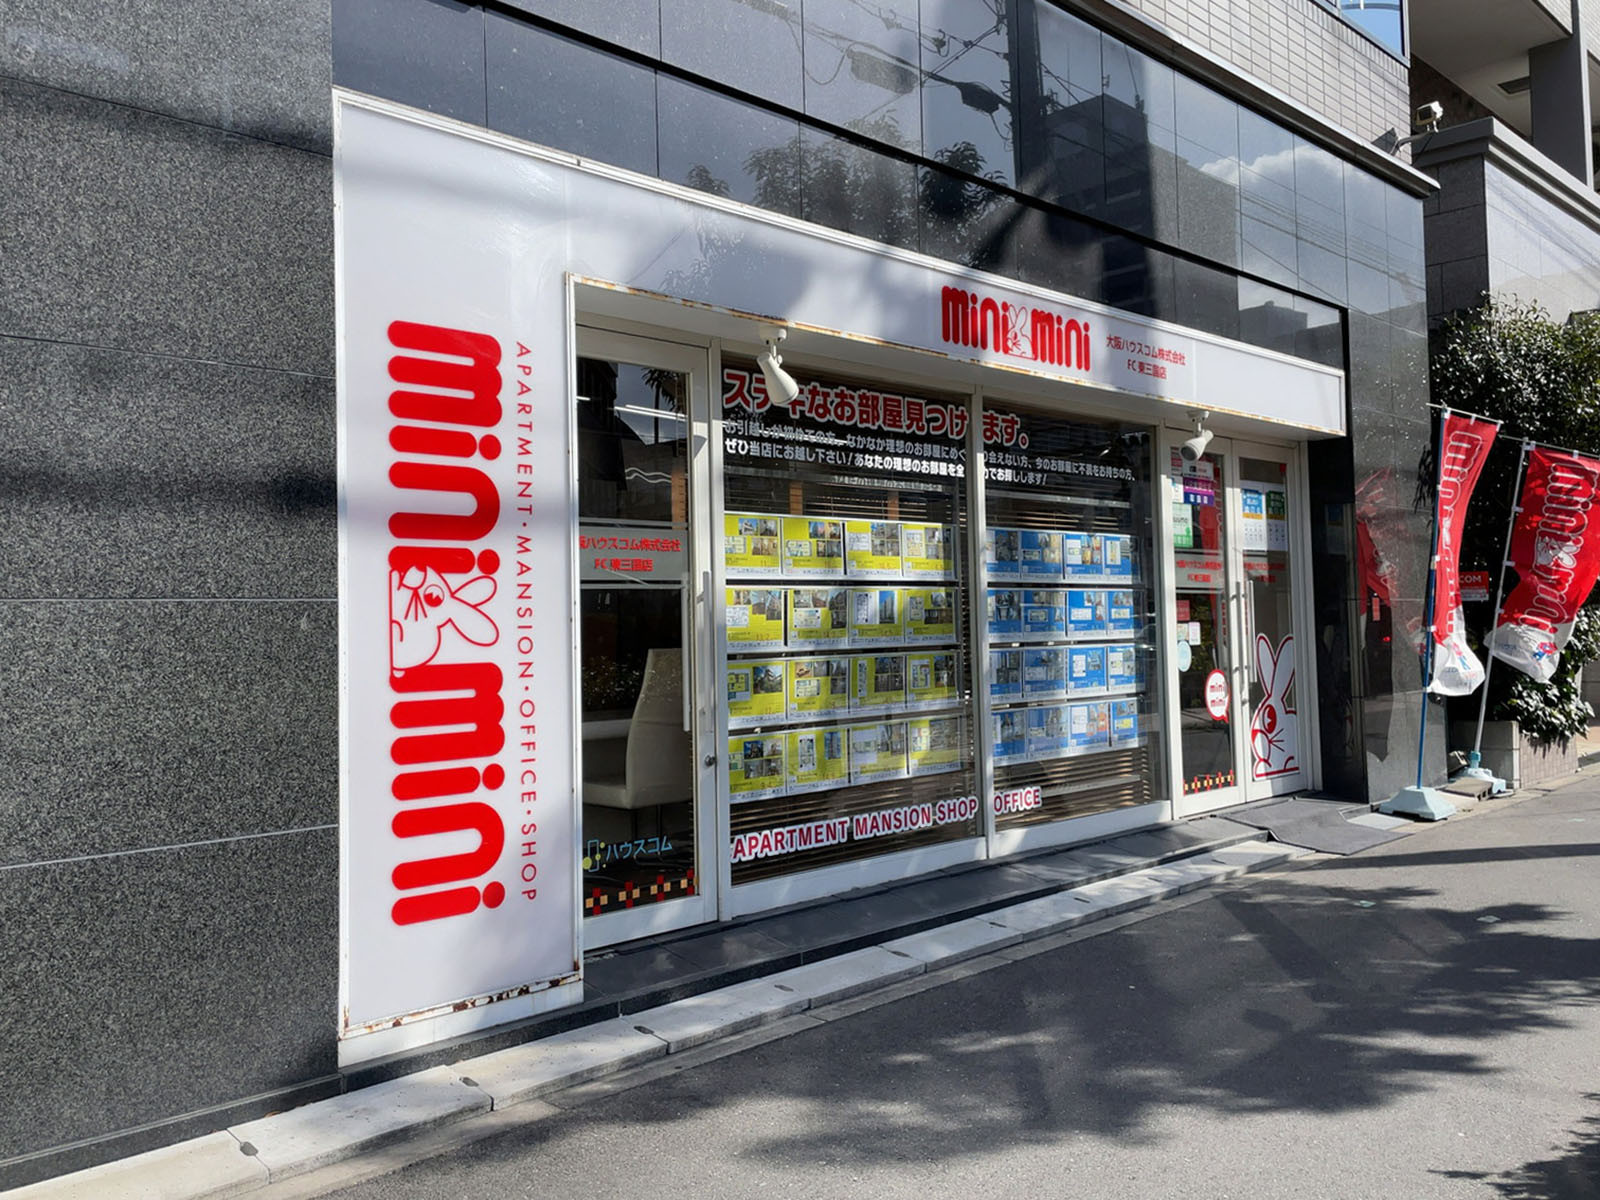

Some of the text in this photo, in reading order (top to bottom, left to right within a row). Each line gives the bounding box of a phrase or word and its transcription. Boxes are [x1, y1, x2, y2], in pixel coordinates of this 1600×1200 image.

[941, 285, 1091, 372] mini mini
[1127, 359, 1136, 371] FC
[387, 319, 506, 927] mini mini
[606, 836, 673, 861] ハウスコム
[731, 786, 1042, 862] APARTMENT MANSION SHOP OFFICE
